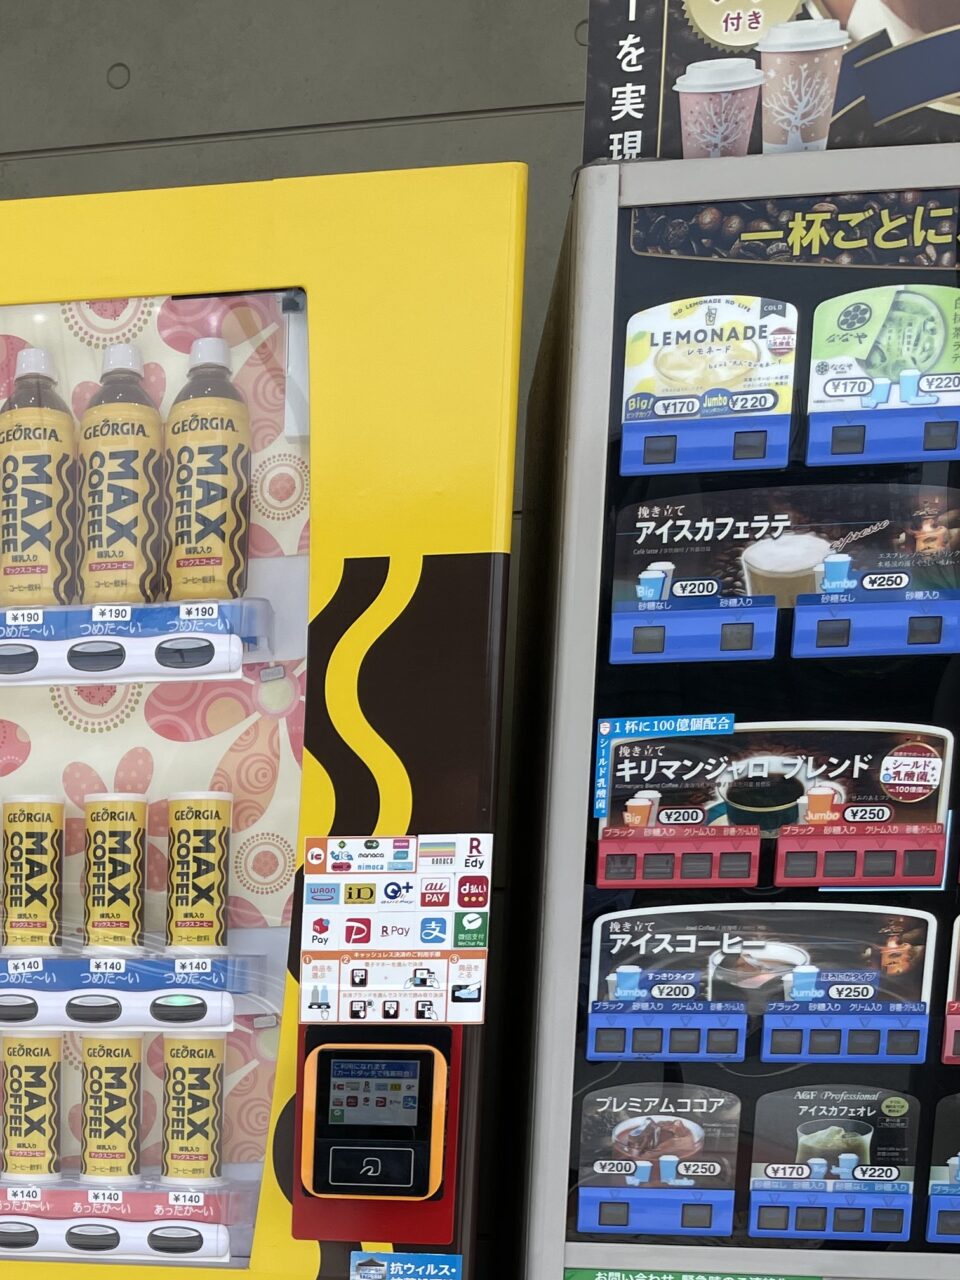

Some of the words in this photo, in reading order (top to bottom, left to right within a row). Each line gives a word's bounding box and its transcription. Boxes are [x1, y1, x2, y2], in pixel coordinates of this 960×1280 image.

[722, 11, 763, 32] 付き
[650, 324, 769, 347] LEMONADE
[687, 345, 732, 356] レモネード
[831, 381, 867, 393] ¥170
[702, 394, 728, 407] Jumbo
[730, 395, 768, 409] ¥220
[662, 401, 695, 414] ¥170
[171, 414, 237, 437] GEORGIA
[175, 446, 194, 547] COFFEE
[193, 444, 228, 544] MAX
[20, 454, 53, 553] MAX
[635, 514, 791, 545] アイスカフェラテ
[868, 575, 903, 588] ¥250
[679, 581, 714, 595] ¥200
[186, 605, 214, 616] ¥190
[615, 757, 769, 782] キリマンジャロ
[782, 754, 873, 780] ブレンド
[665, 810, 699, 822] ¥200
[850, 808, 885, 820] ¥250
[603, 828, 636, 838] ブラック
[782, 826, 815, 835] ブラック
[175, 829, 190, 907] COFFEE
[191, 829, 216, 906] MAX
[464, 858, 484, 869] Edy
[425, 893, 445, 903] PAY
[391, 925, 411, 936] Pay
[311, 935, 329, 945] Pay
[609, 933, 766, 955] アイスコーヒー
[13, 961, 40, 970] ¥140
[180, 962, 208, 971] ¥140
[647, 973, 696, 981] すっきりタイプ
[657, 986, 690, 998] ¥200
[835, 987, 870, 999] ¥250
[593, 1001, 625, 1011] ブラック
[768, 1002, 800, 1012] ブラック
[822, 1091, 882, 1103] Professional
[595, 1096, 726, 1114] プレミアムココア
[798, 1105, 877, 1117] アイスカフェオレ
[598, 1161, 632, 1173] ¥200
[682, 1163, 717, 1175] ¥250
[771, 1165, 805, 1177] ¥170
[860, 1167, 893, 1179] ¥220
